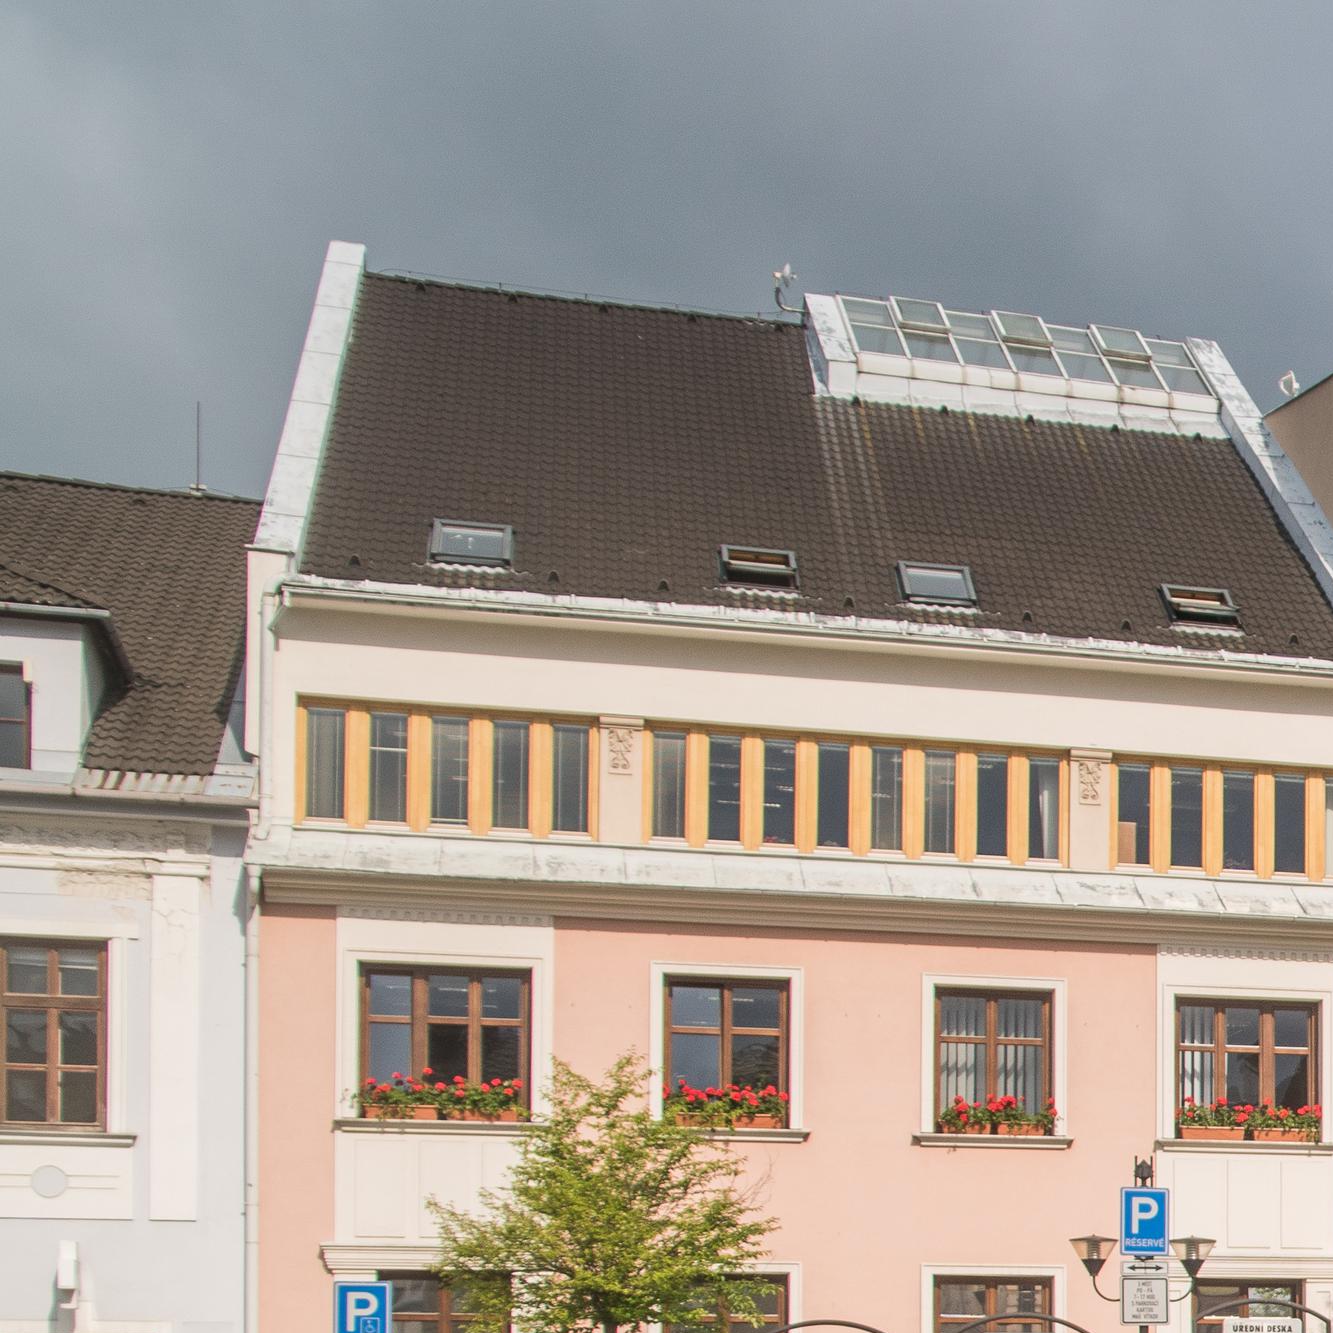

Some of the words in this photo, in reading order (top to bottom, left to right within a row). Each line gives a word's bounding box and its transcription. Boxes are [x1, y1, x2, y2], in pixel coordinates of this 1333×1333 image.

[1131, 1196, 1159, 1235] P
[1125, 1237, 1165, 1248] RÉSERVÉ
[346, 1291, 379, 1333] P
[1267, 1324, 1293, 1333] DESKA
